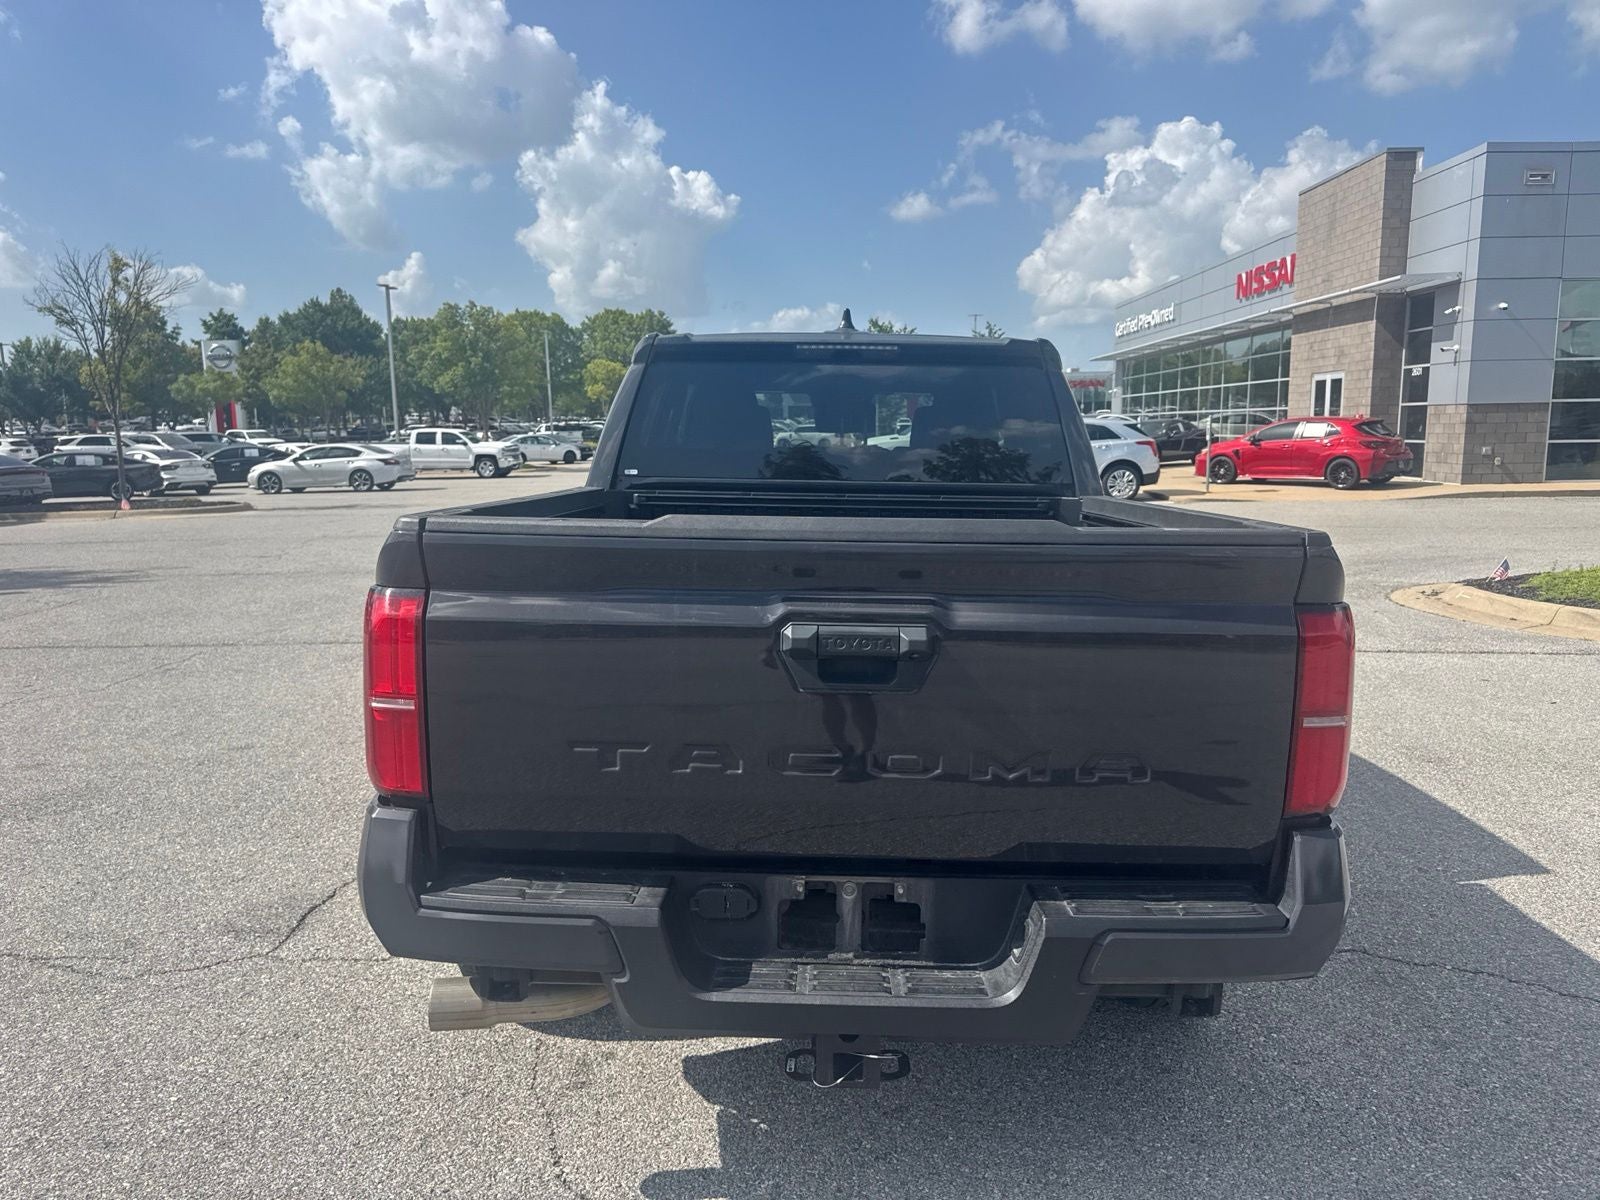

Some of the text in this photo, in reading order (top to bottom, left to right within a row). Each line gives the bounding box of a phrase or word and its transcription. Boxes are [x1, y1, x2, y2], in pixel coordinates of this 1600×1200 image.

[1115, 302, 1175, 337] Certified Pre-Owned
[823, 637, 897, 651] TOYOTA
[568, 741, 1150, 783] TACOMA
